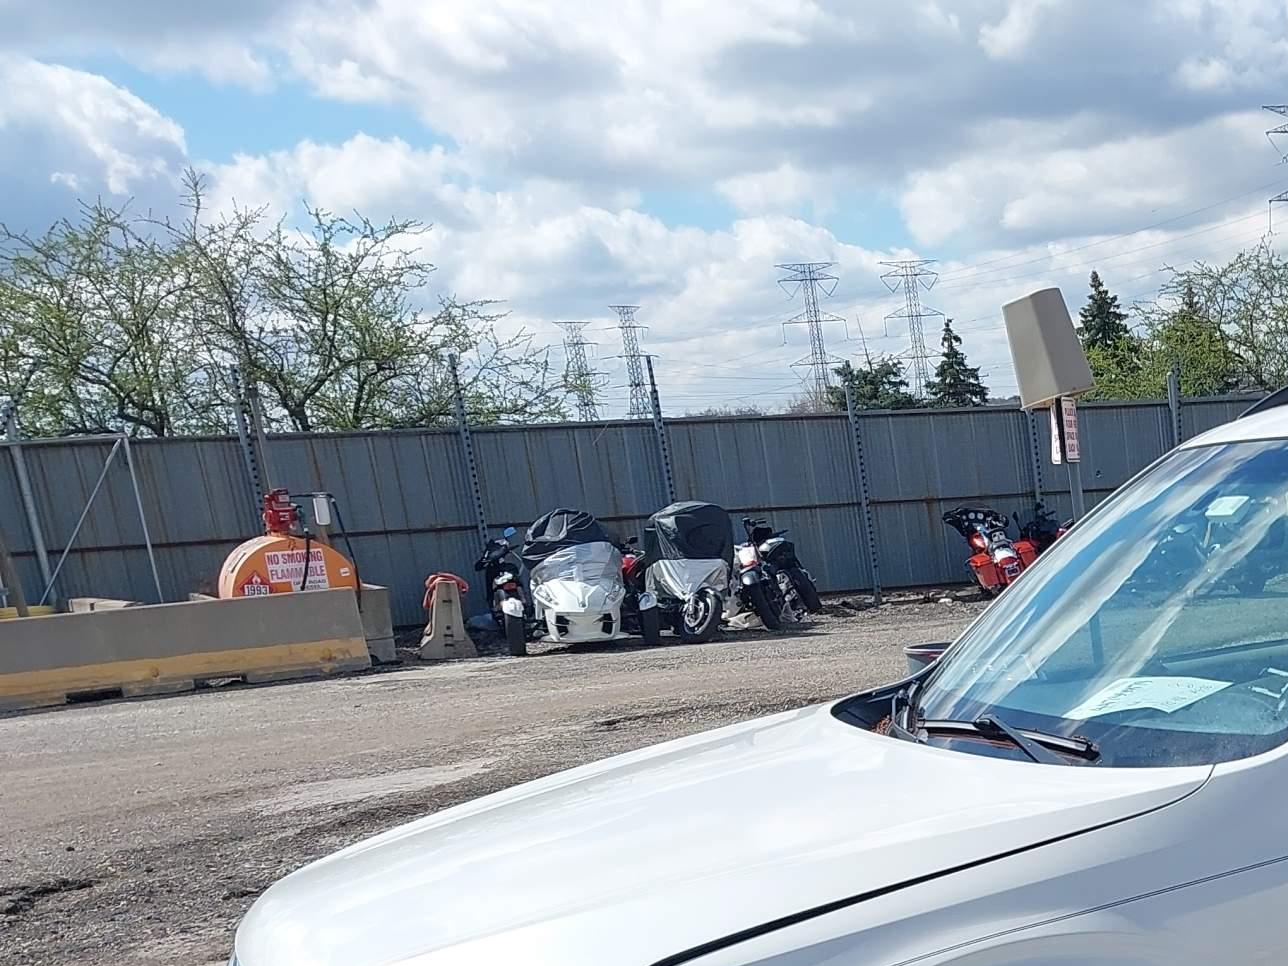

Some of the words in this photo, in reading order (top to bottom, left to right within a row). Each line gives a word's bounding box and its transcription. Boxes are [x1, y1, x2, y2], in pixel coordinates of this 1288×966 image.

[266, 554, 280, 566] NO
[269, 565, 326, 580] FLAMMBLE
[246, 585, 268, 596] 1993
